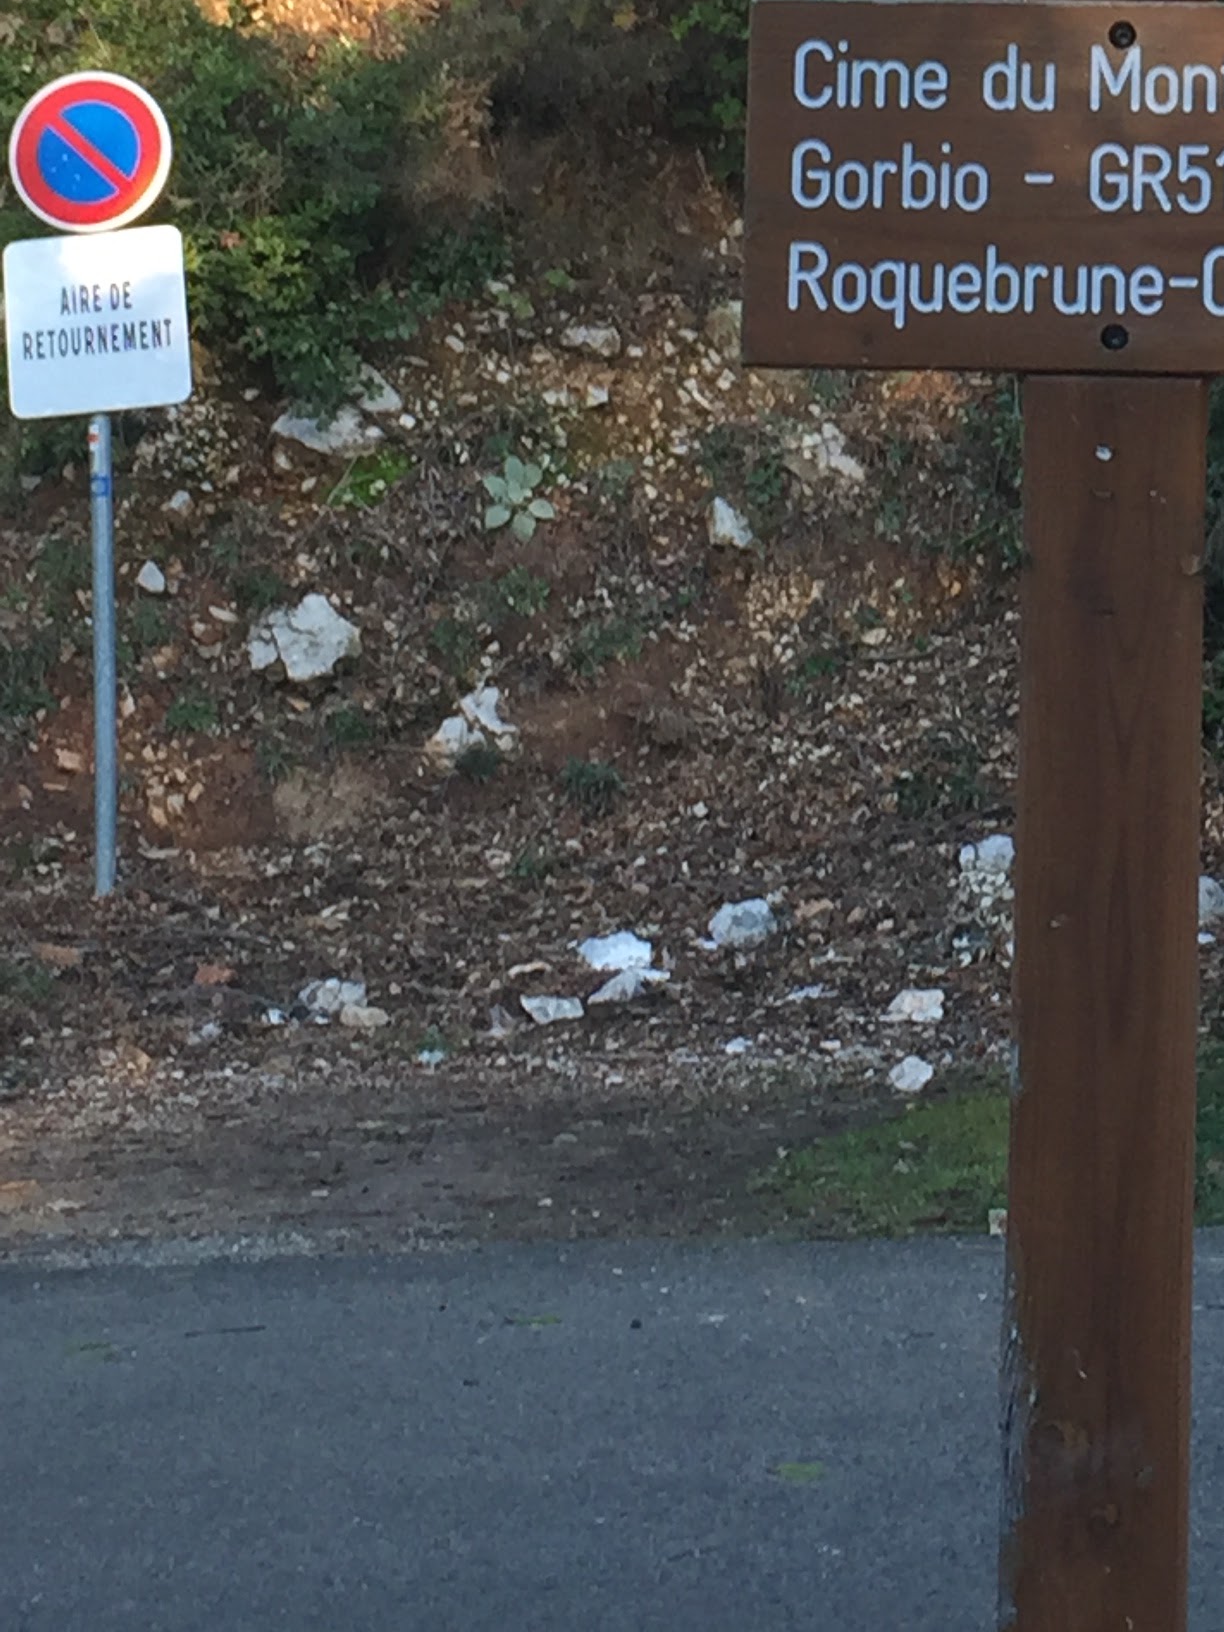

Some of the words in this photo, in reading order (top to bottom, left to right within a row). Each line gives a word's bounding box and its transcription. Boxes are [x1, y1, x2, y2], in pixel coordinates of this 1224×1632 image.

[793, 39, 948, 110] Cime
[982, 43, 1056, 112] du
[790, 138, 989, 212] Gorbio
[60, 285, 102, 316] AIRE
[109, 281, 132, 310] DE
[22, 318, 173, 361] RETOURNEMENT
